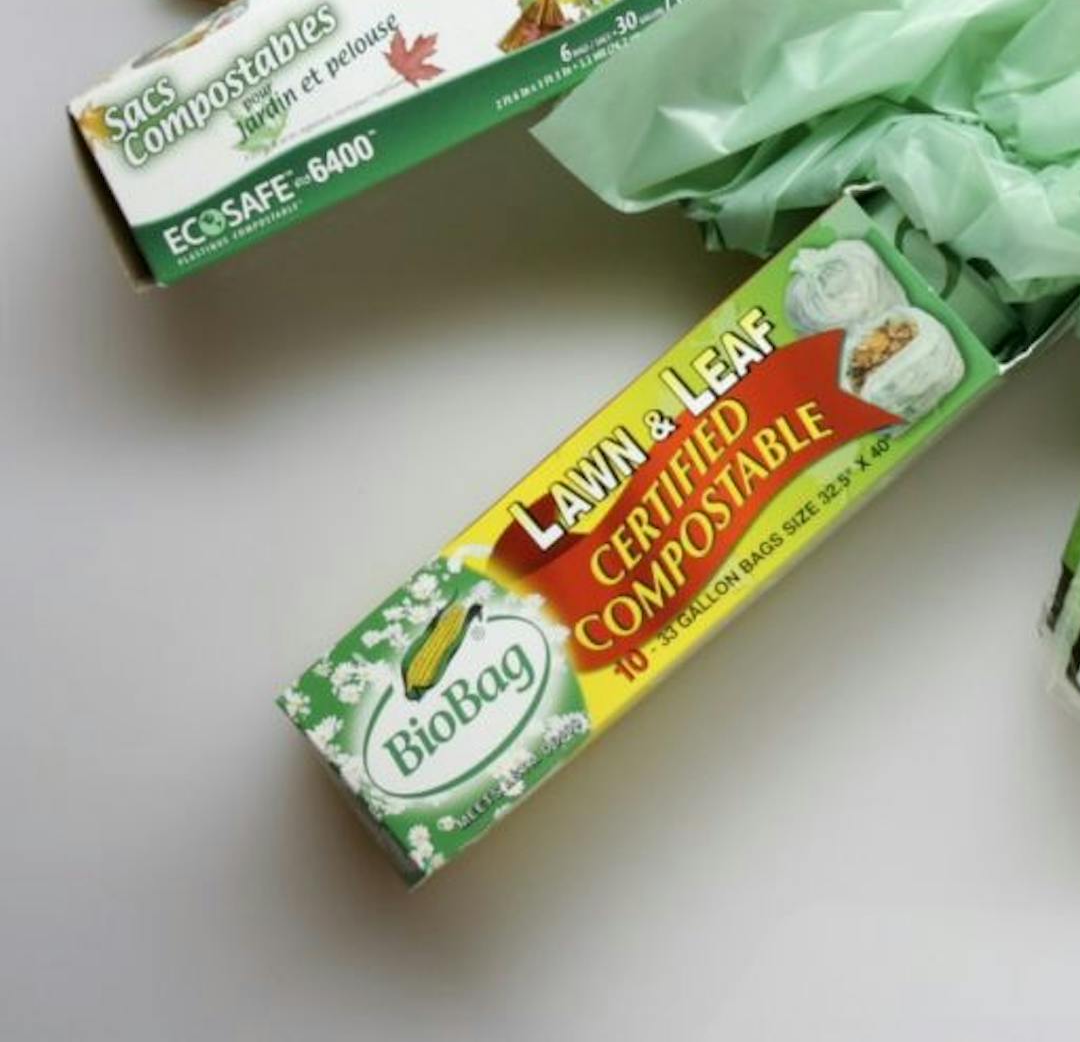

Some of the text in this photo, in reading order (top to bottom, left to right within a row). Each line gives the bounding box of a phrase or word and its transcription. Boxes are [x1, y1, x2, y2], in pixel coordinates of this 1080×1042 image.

[123, 4, 337, 167] Compostables
[235, 86, 298, 142] Jardin
[301, 70, 323, 92] et
[328, 12, 400, 79] pelouse
[242, 83, 275, 110] pour
[615, 10, 639, 35] 30
[105, 75, 177, 142] Sacs
[509, 305, 776, 553] LAWN & LEAF
[589, 396, 750, 587] CERTIFIED
[573, 399, 835, 653] COMPOSTABLE
[614, 647, 650, 684] 10
[655, 626, 679, 648] 33
[678, 574, 741, 631] GALLON
[737, 531, 787, 575] BAGS
[782, 501, 822, 535] SIZE
[816, 467, 858, 509] 32.5"
[856, 455, 873, 472] X
[382, 643, 536, 778] BioBag
